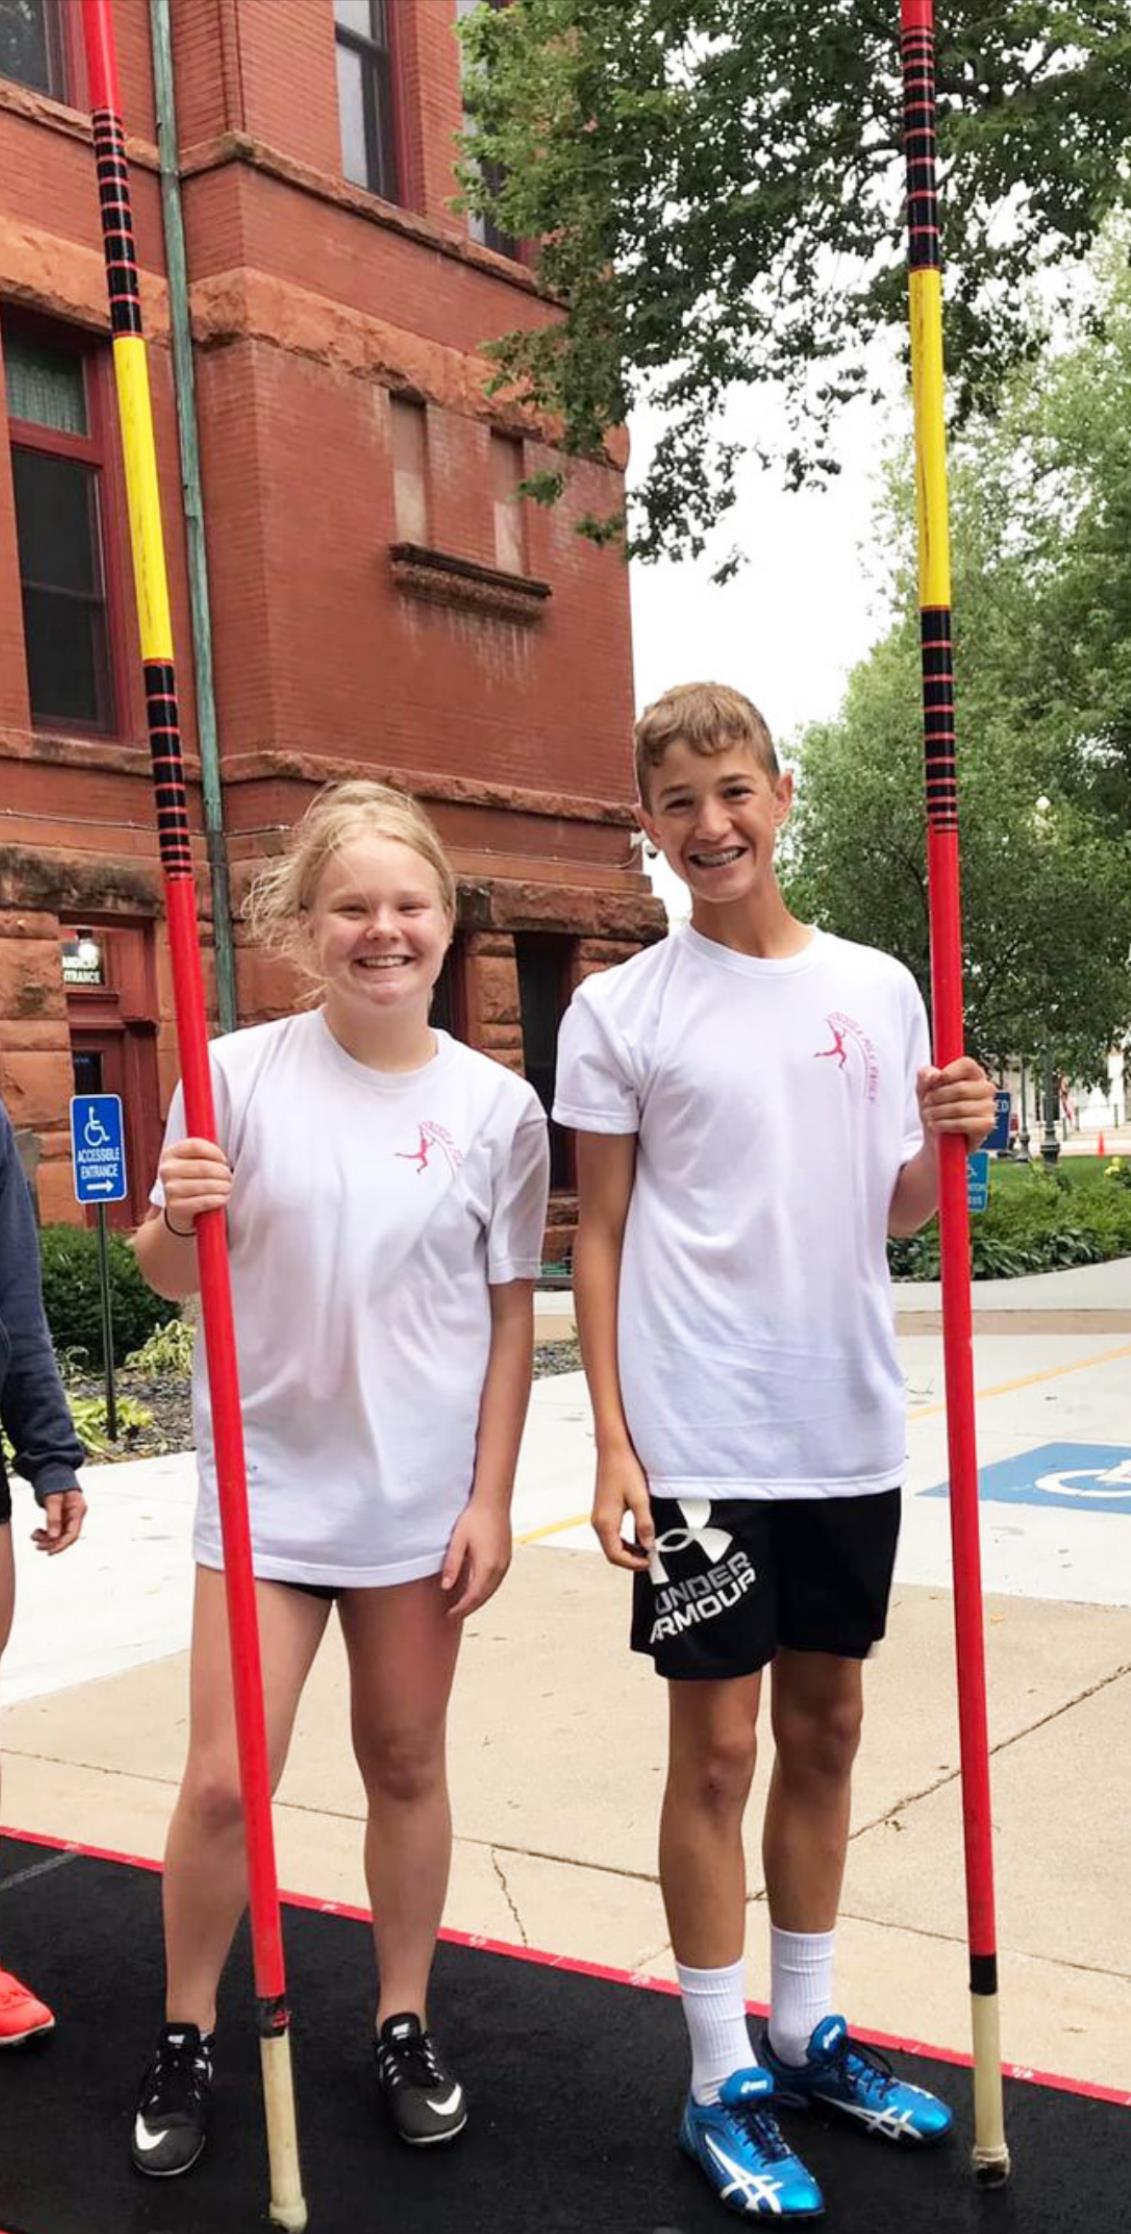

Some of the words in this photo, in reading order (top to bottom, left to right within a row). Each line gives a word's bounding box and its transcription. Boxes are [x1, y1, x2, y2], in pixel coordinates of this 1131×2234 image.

[78, 1146, 120, 1163] ACCESSIBLE
[80, 1163, 119, 1180] ENTRANCE
[655, 1551, 751, 1615] UNDER
[649, 1568, 757, 1645] ARMOUR
